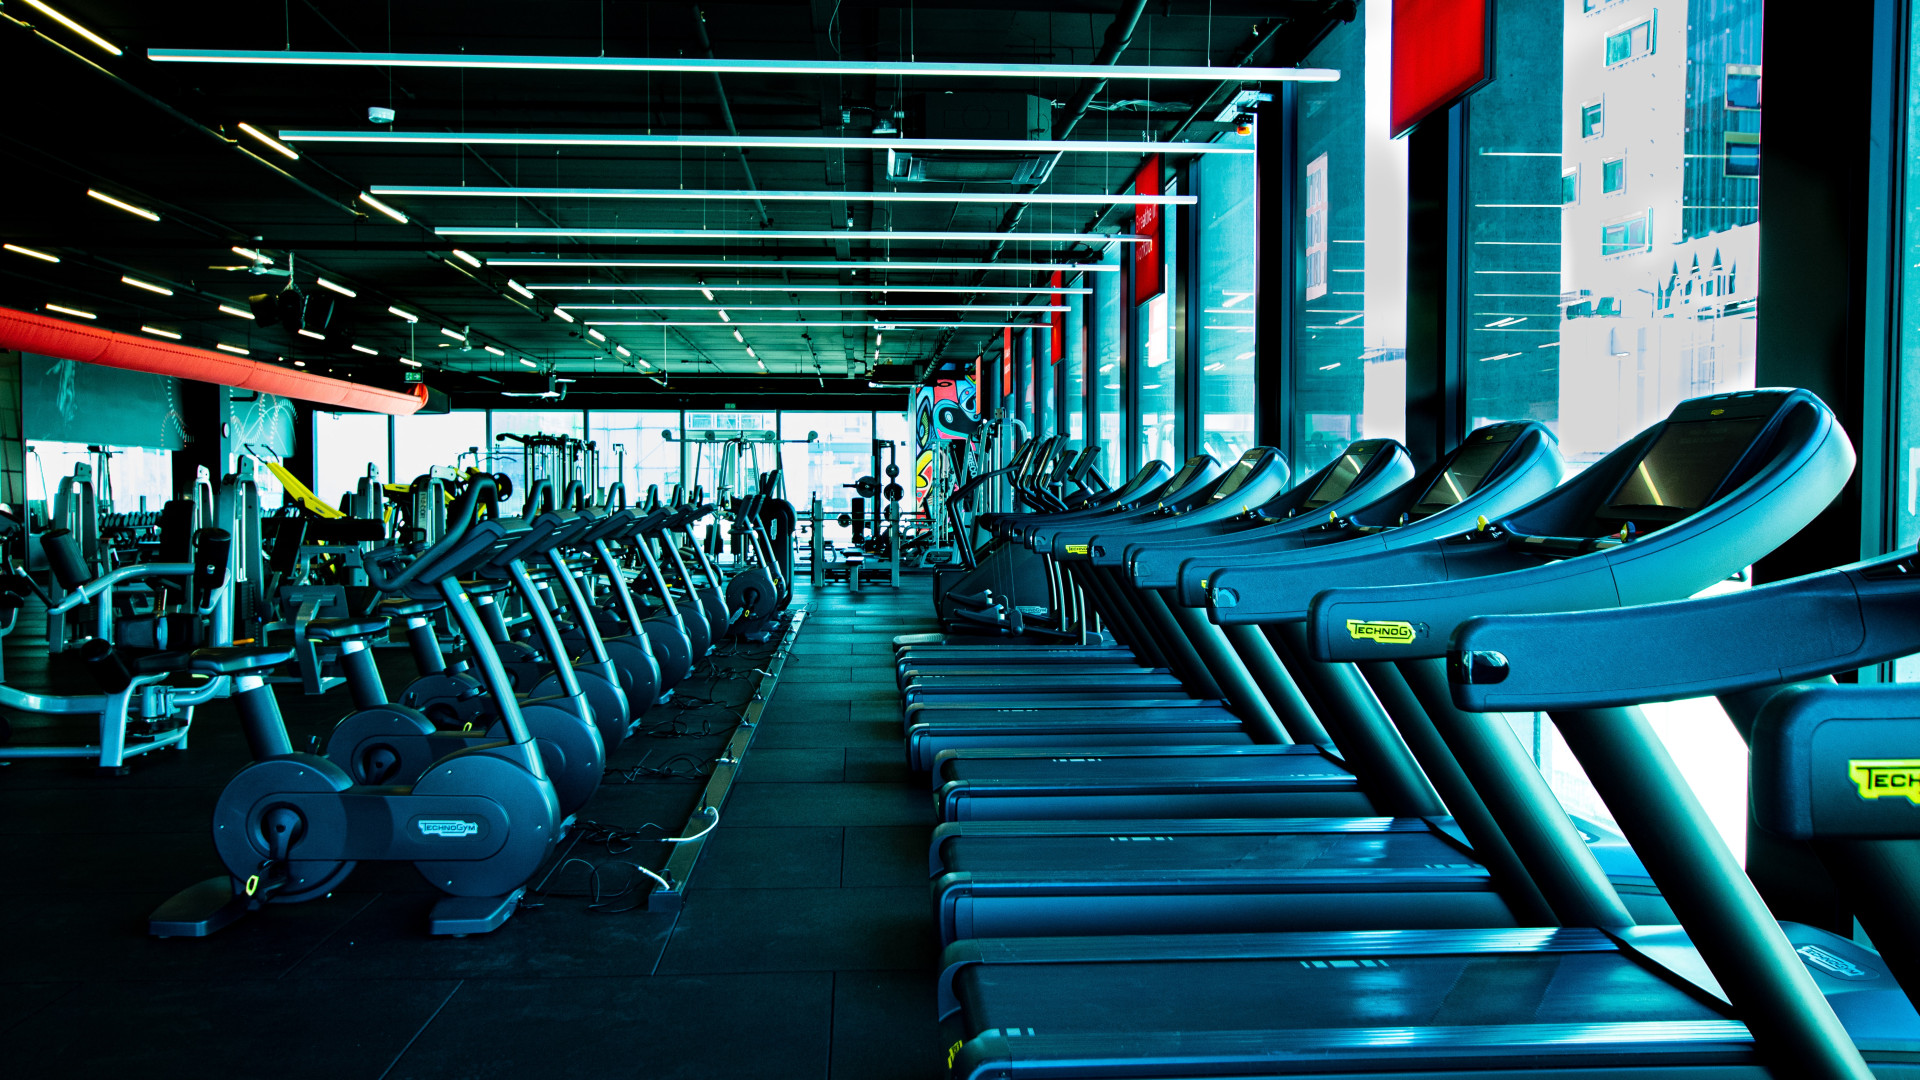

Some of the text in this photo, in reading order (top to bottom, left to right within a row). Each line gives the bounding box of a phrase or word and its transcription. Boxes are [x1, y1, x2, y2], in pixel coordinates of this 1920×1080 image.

[1349, 622, 1413, 640] TECHNOG
[1855, 766, 1920, 791] TECH
[419, 822, 477, 834] TECHNOGYM
